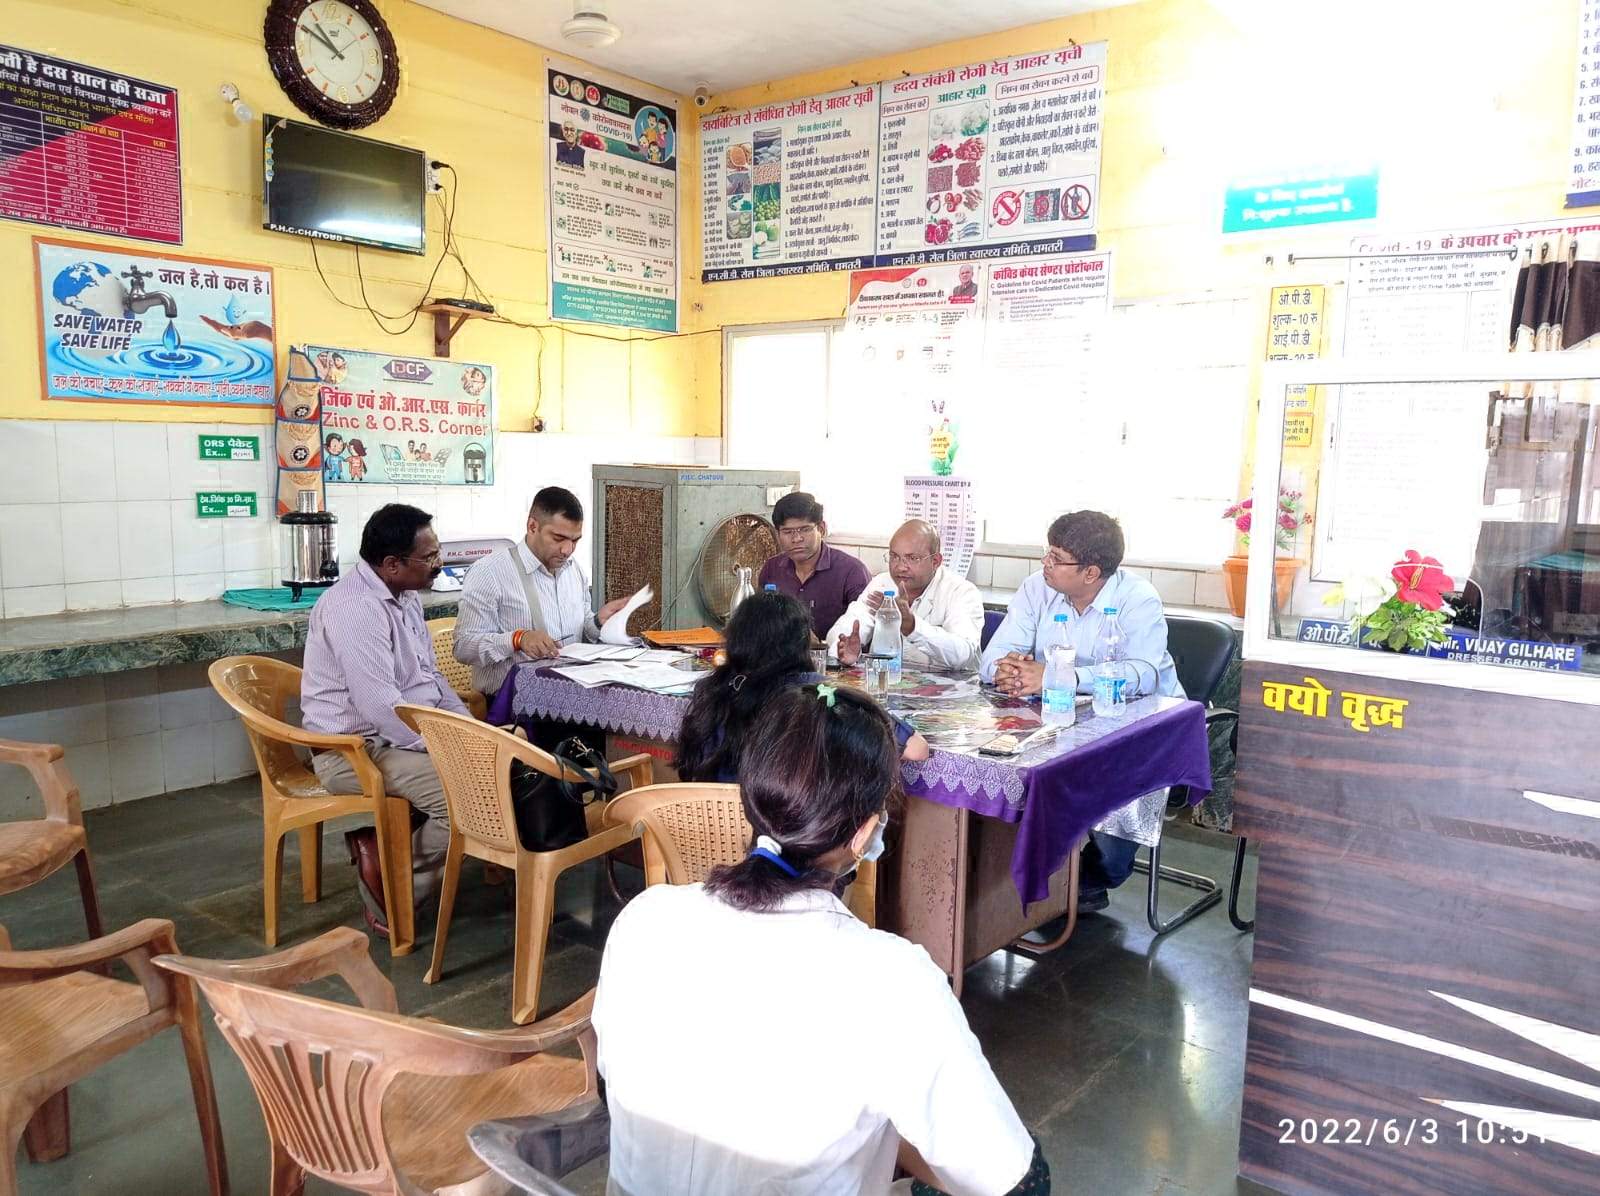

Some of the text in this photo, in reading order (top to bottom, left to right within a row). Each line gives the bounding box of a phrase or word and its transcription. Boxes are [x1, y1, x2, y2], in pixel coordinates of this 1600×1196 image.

[960, 64, 986, 80] रोगी
[991, 60, 1009, 75] हेतु
[1013, 55, 1050, 71] आहार
[1054, 46, 1082, 65] सूची
[23, 54, 167, 105] है दस साल की सजा
[937, 84, 986, 103] आहार सूची
[744, 110, 751, 124] से
[787, 100, 806, 116] रोगी
[809, 98, 822, 115] हेतु
[826, 95, 852, 110] आहार
[854, 87, 873, 107] सूची
[596, 123, 632, 141] (COVID-19)
[158, 268, 185, 286] जल
[224, 275, 250, 293] कल
[53, 313, 143, 334] SAVE WATER
[1300, 313, 1309, 324] 10
[61, 333, 132, 351] SAVE LIFE
[356, 390, 375, 409] एवं
[322, 412, 487, 436] Zinc & O.R.S. Corner
[204, 439, 224, 447] ORS
[1464, 638, 1507, 656] VIJAY
[1509, 642, 1576, 662] GILHARE
[1262, 677, 1409, 732] वयो वृद्ध
